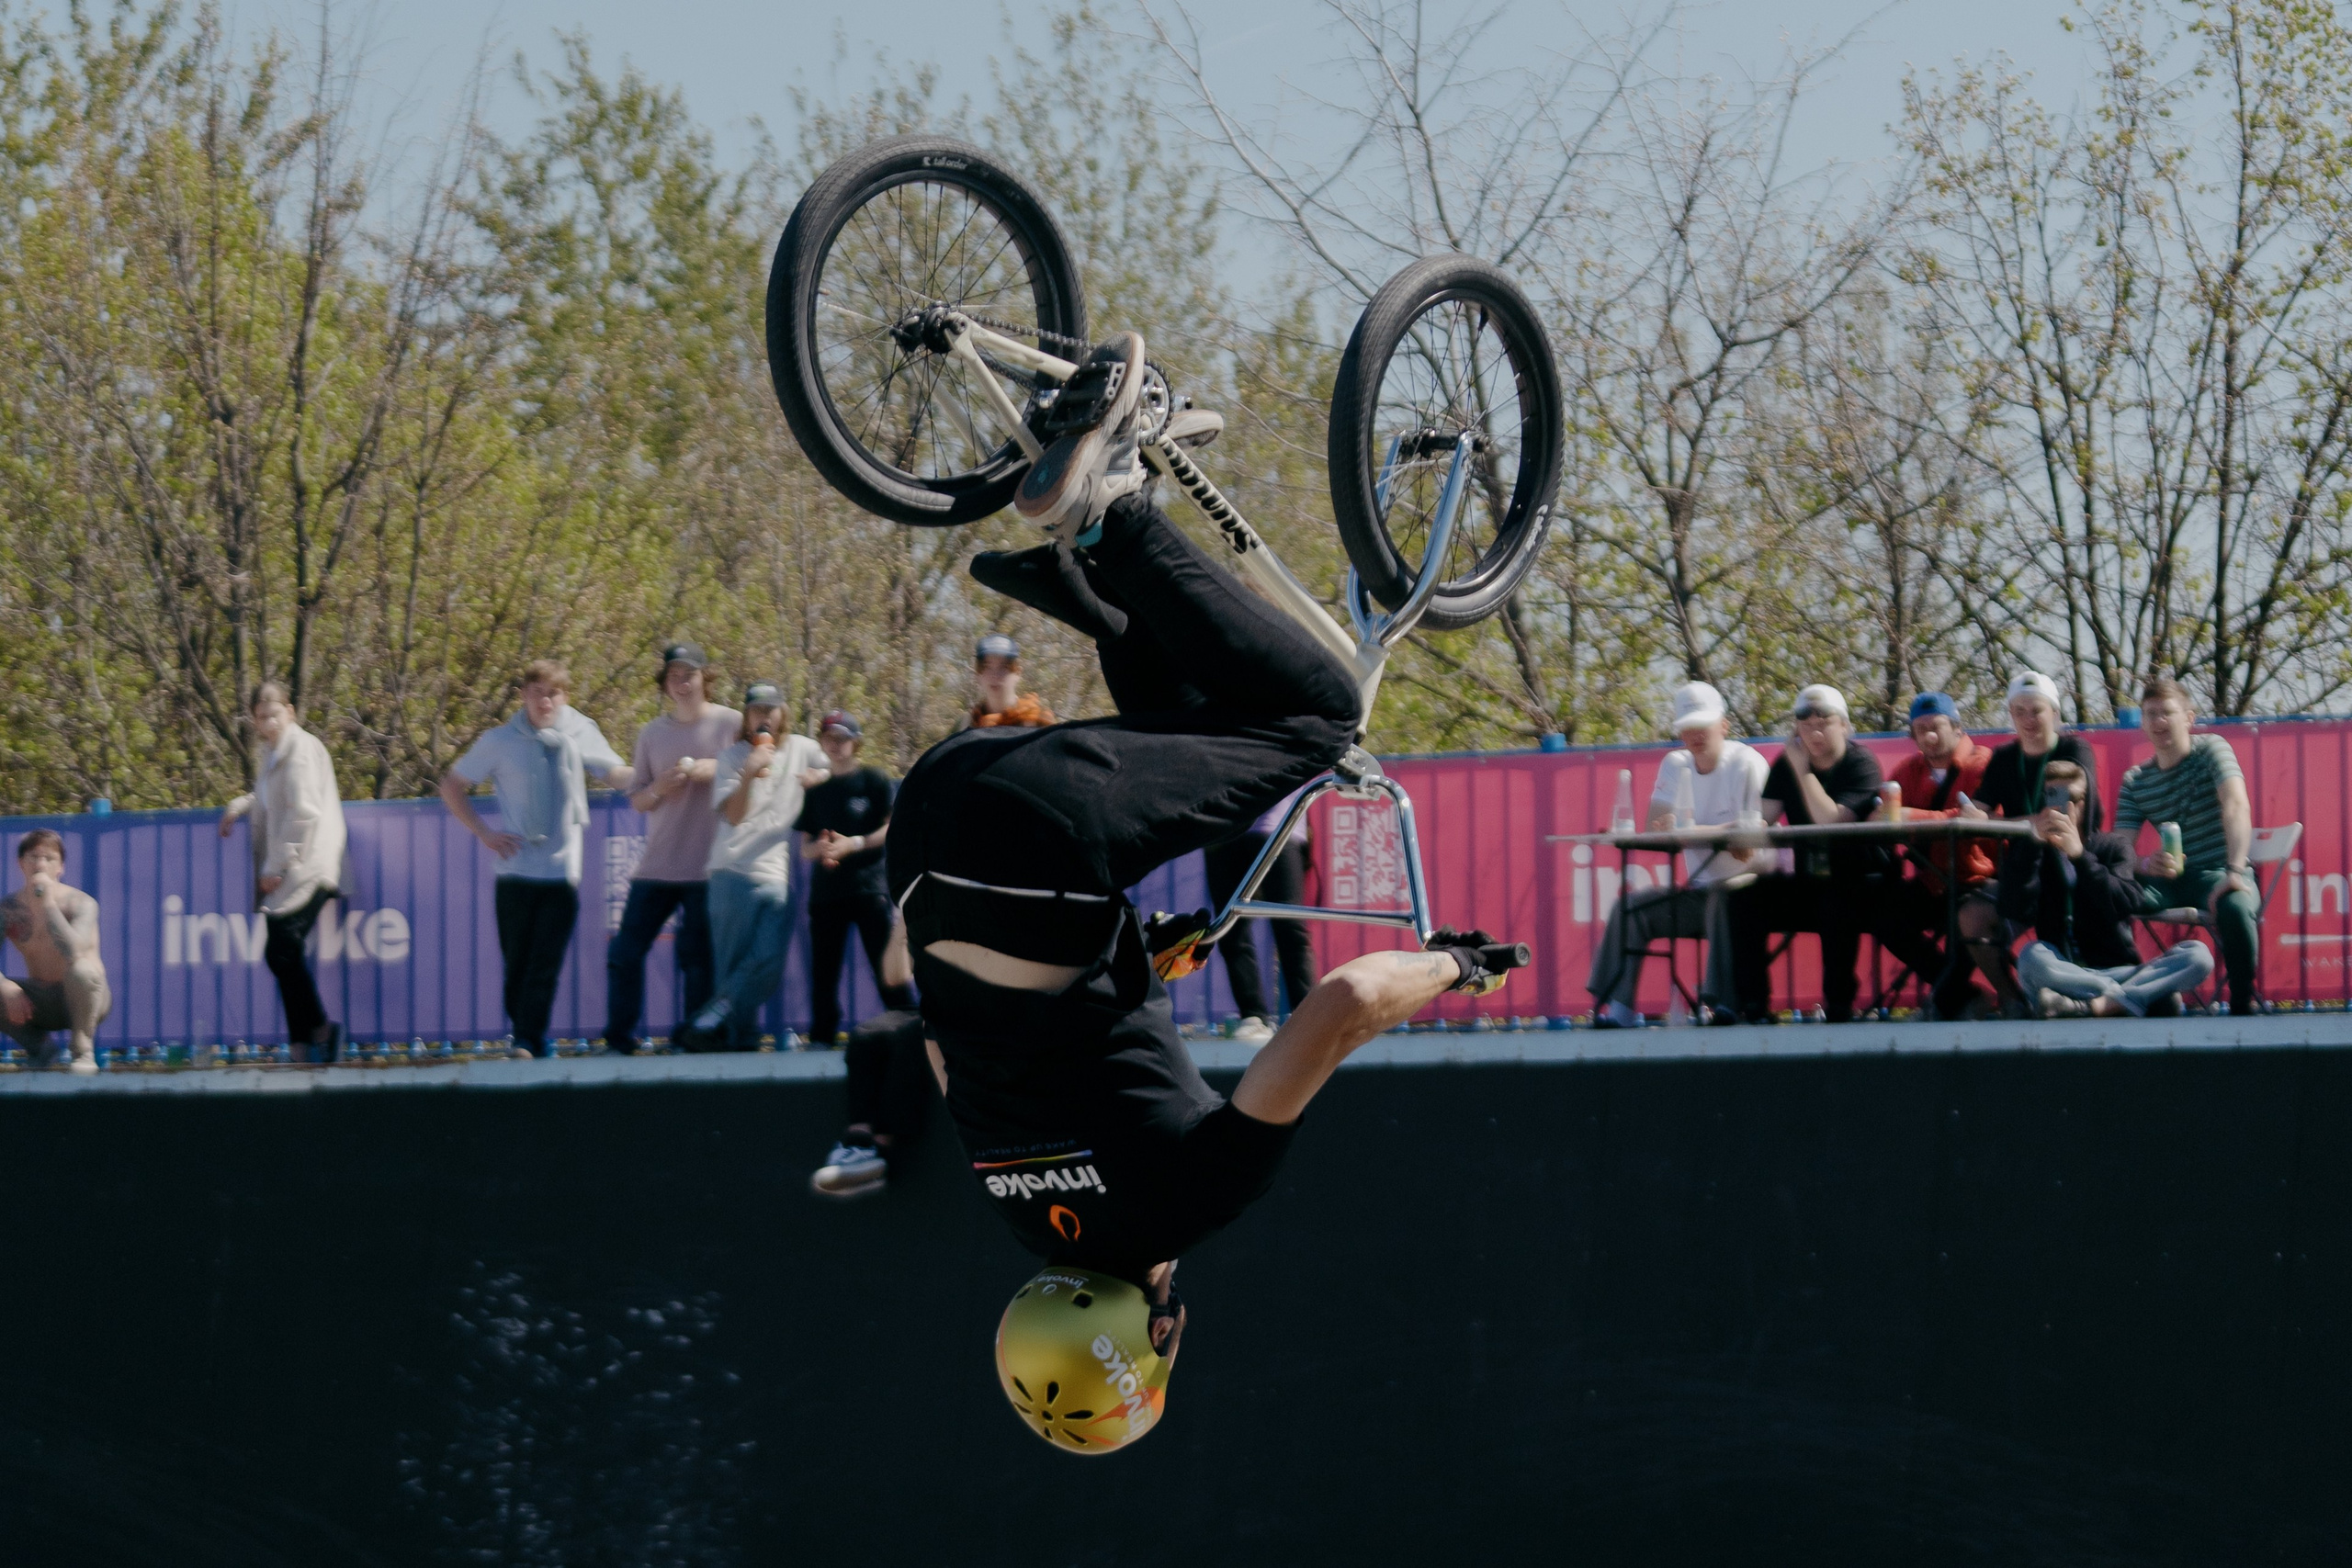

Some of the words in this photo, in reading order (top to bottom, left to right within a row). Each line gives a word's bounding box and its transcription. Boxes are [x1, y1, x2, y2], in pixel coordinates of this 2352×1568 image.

[1571, 843, 1674, 923] in
[2289, 858, 2352, 914] in
[164, 894, 411, 963] invke
[986, 1164, 1107, 1200] invoke
[1091, 1334, 1147, 1441] invoke
